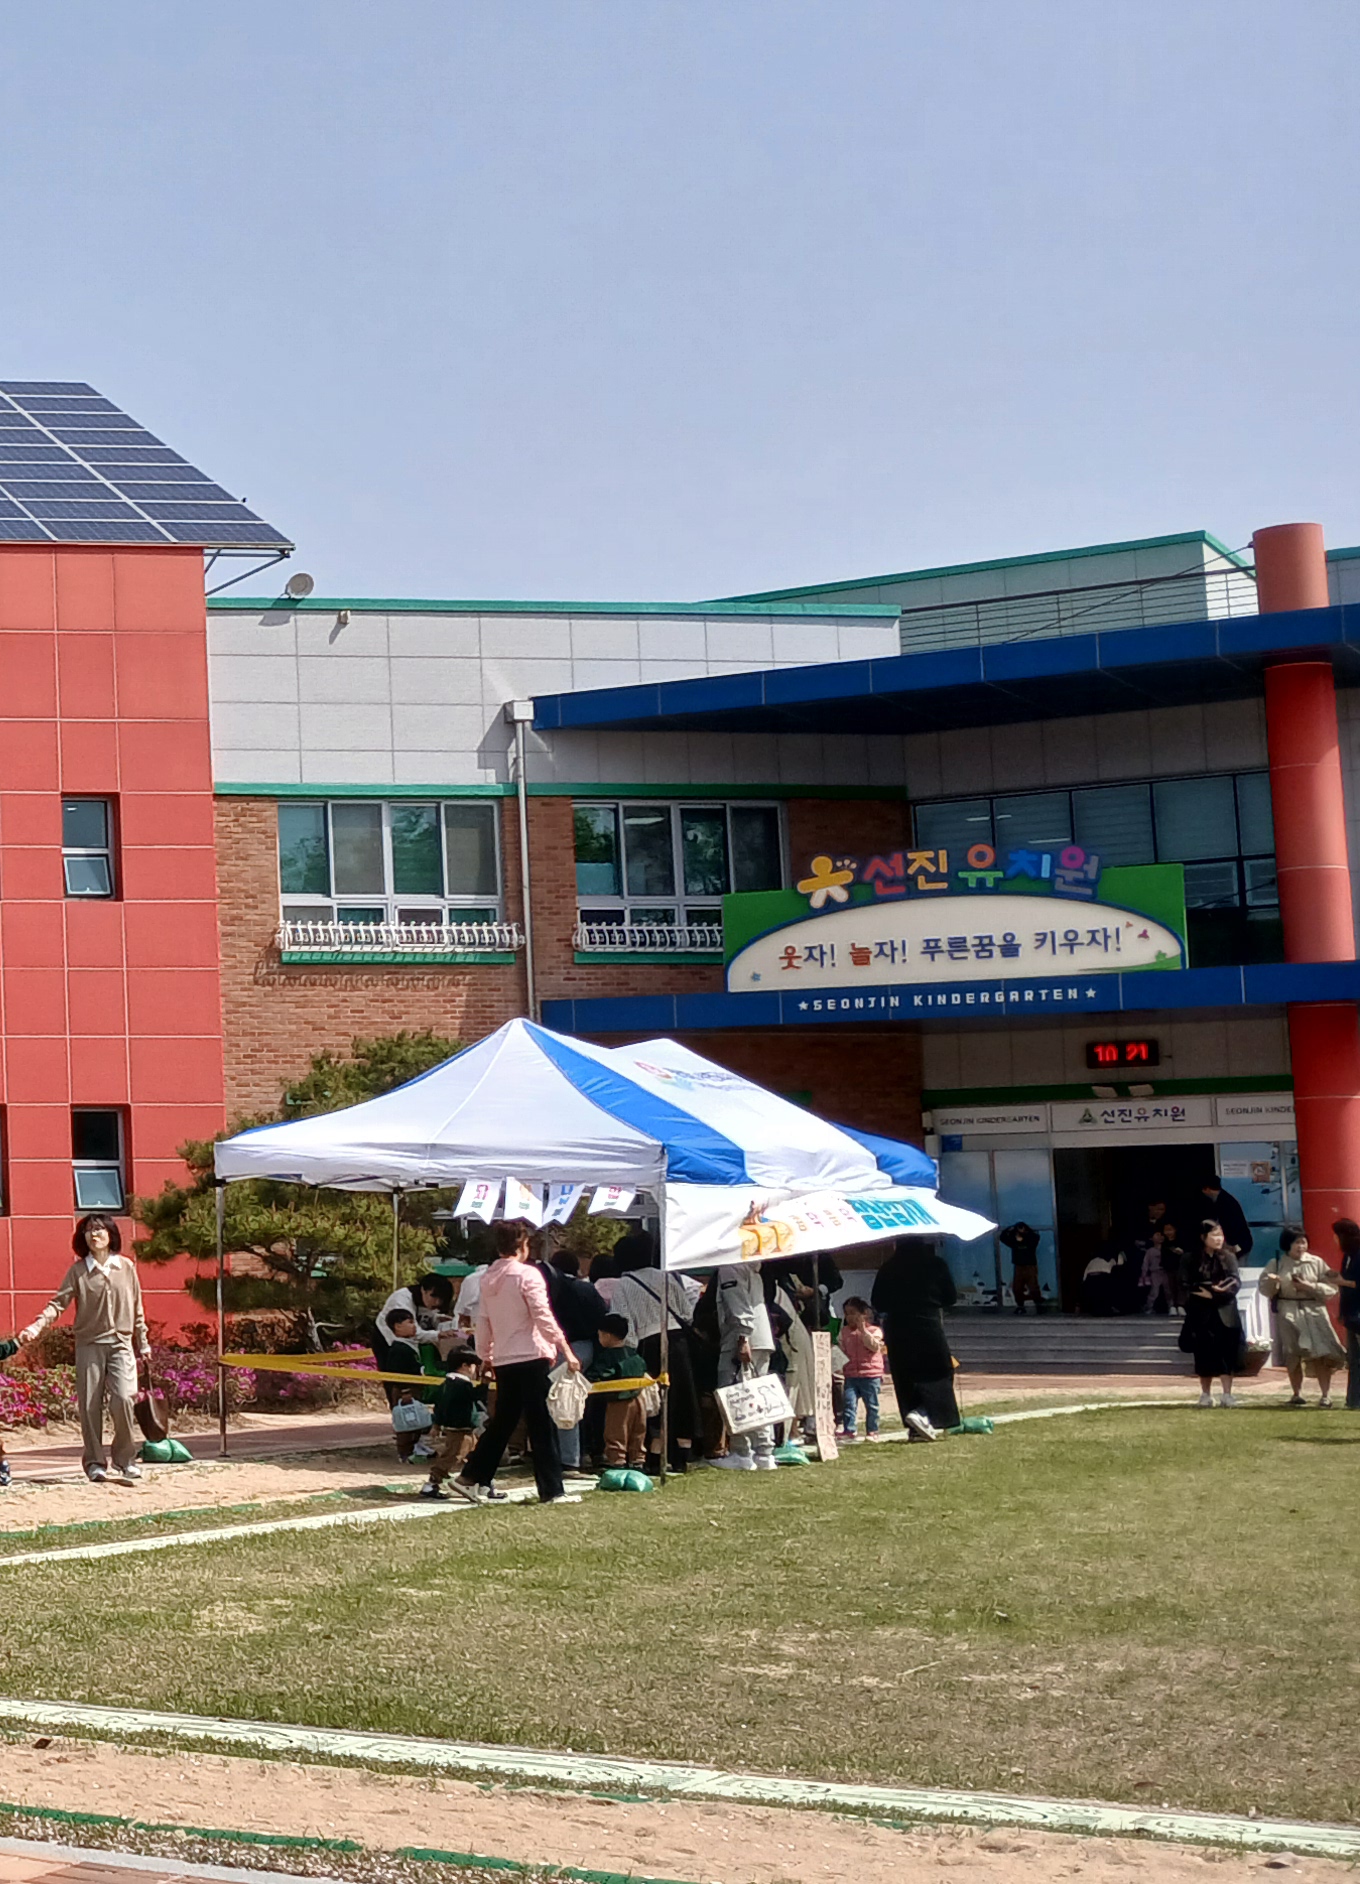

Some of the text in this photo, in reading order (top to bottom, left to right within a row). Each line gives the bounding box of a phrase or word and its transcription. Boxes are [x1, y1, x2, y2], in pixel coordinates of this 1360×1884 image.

[863, 843, 1100, 896] 선진유치원
[779, 925, 1122, 971] 웃자! 놀자! 푸른꿈을 키우자!
[812, 987, 1078, 1011] SEONJIN KINDERGARTEN
[1099, 1106, 1186, 1125] 선진유치원
[1225, 1105, 1263, 1116] SEONJIN
[939, 1116, 975, 1127] SEONJIN
